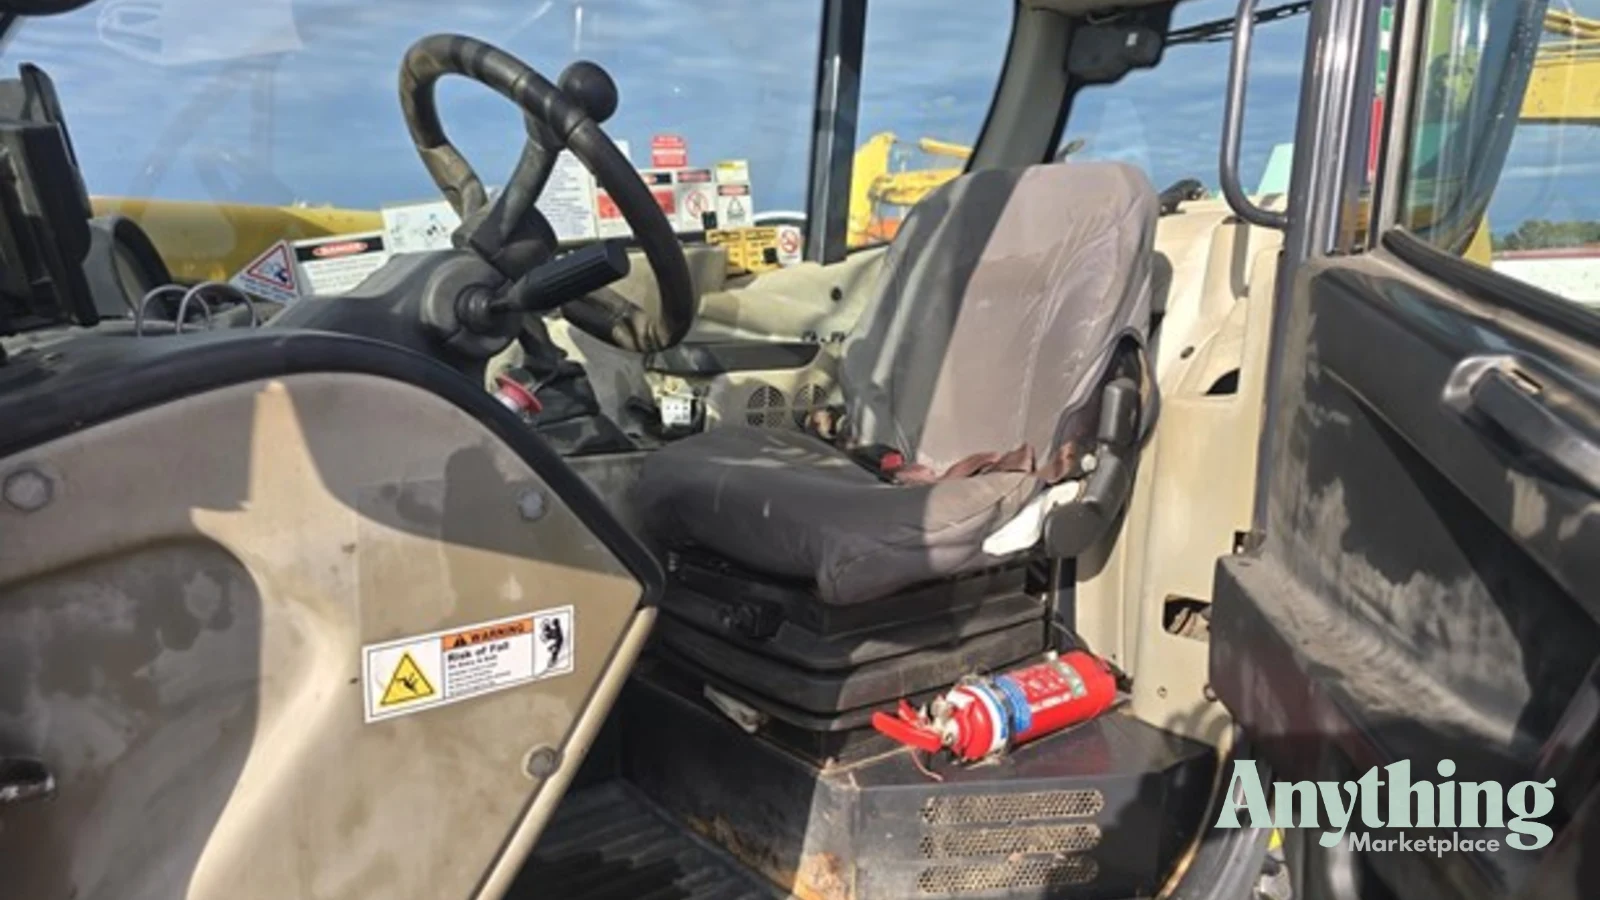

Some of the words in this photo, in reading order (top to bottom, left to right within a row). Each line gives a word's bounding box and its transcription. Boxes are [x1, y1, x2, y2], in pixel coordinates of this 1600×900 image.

[470, 623, 524, 644] WARNING
[447, 650, 471, 662] Risk
[475, 646, 487, 656] of
[489, 641, 510, 653] Fall
